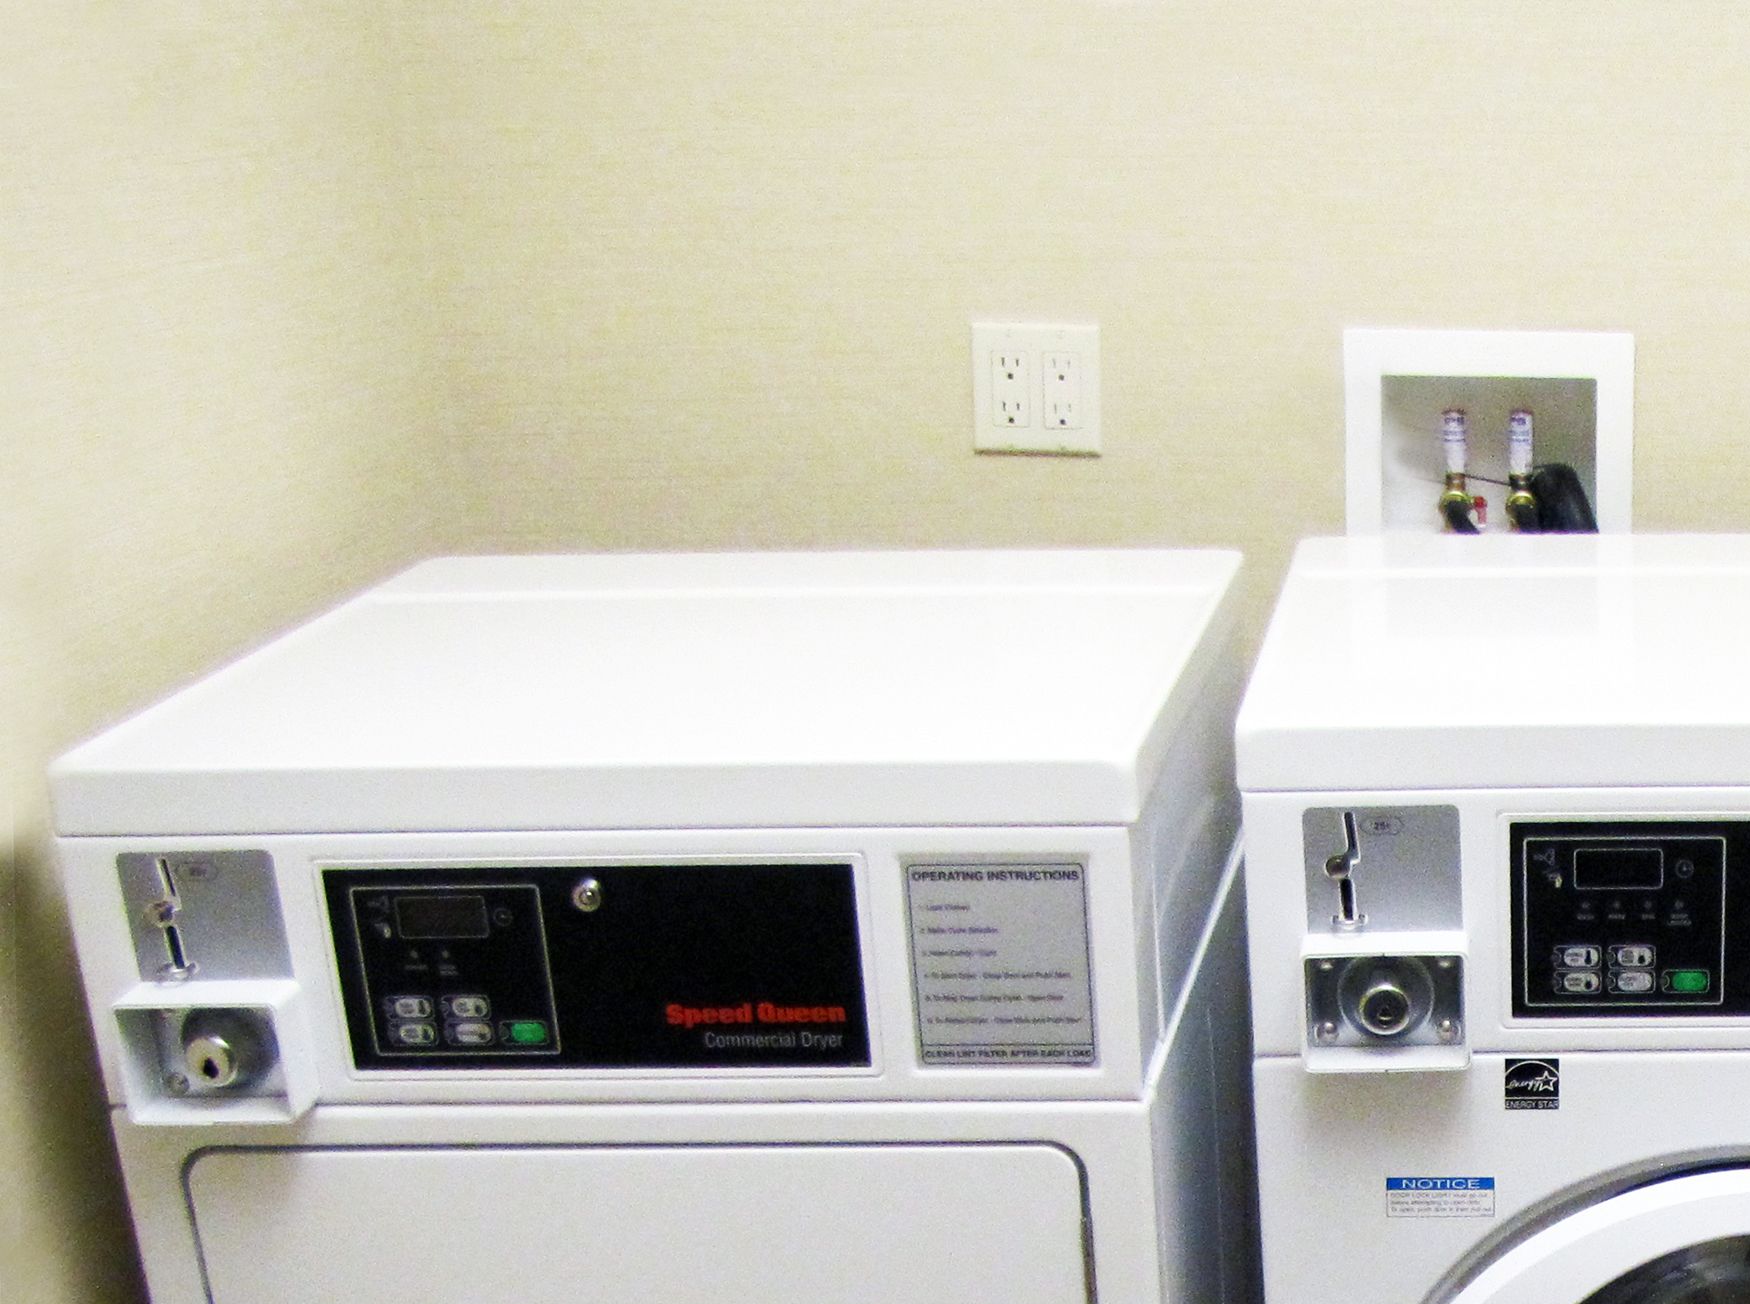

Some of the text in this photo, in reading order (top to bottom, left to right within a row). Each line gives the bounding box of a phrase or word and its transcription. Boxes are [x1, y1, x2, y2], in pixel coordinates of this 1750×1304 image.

[911, 870, 1080, 881] OPERATING INSTRUCTIONS
[665, 1001, 847, 1029] Speed Queen
[704, 1031, 843, 1050] Commercial Dryer
[1505, 1100, 1559, 1109] ENERGY STAR
[1402, 1179, 1480, 1189] NOTICE
